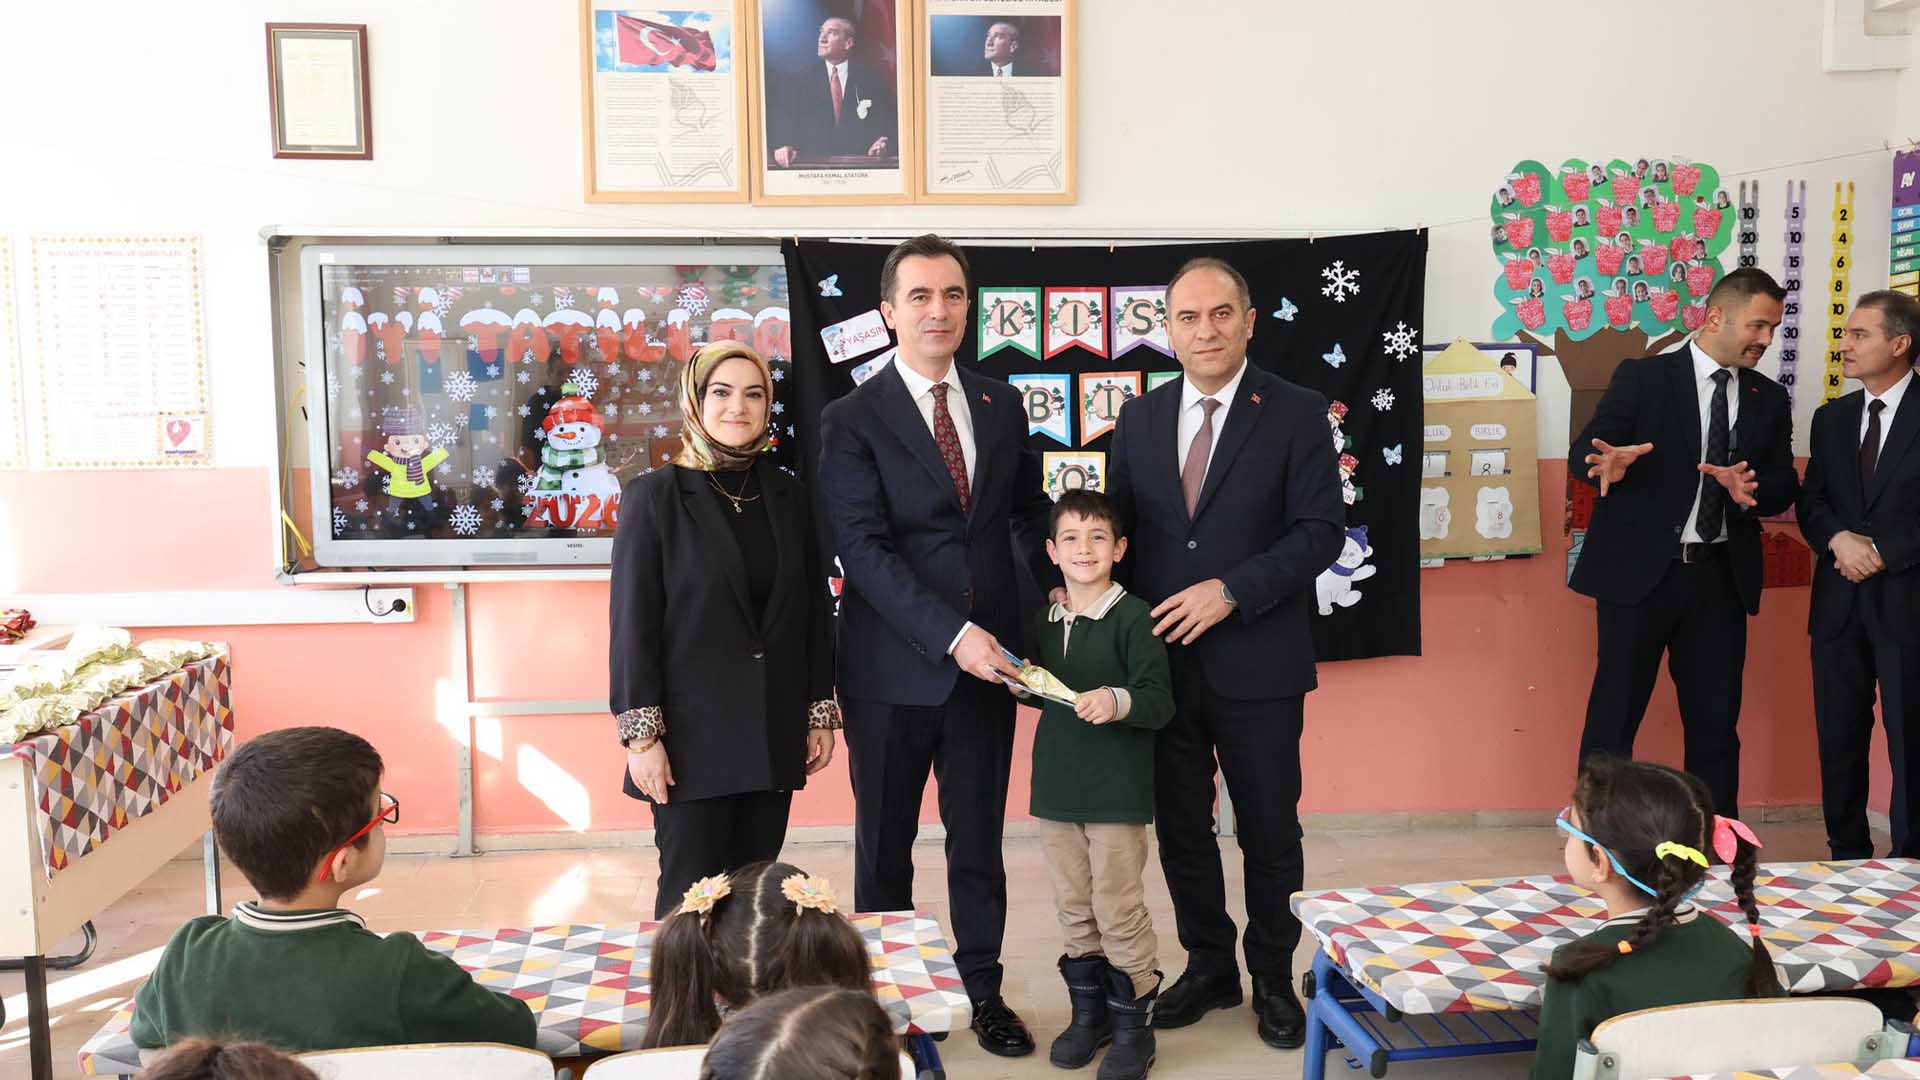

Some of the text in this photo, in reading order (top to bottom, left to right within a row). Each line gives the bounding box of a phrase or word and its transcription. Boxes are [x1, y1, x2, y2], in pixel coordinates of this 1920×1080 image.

[1901, 171, 1915, 188] AY
[1743, 208, 1754, 219] 10
[1792, 207, 1799, 218] 5
[1840, 209, 1847, 221] 2
[1742, 232, 1755, 243] 20
[1790, 232, 1801, 243] 10
[1839, 233, 1846, 244] 4
[1741, 255, 1755, 267] 30
[1789, 256, 1799, 267] 15
[1837, 256, 1844, 268] 6
[1787, 280, 1799, 291] 20
[1835, 280, 1842, 291] 8
[1785, 303, 1797, 314] 25
[1833, 304, 1844, 315] 10
[1784, 327, 1798, 338] 30
[1832, 328, 1842, 338] 12
[1783, 350, 1795, 361] 35
[1830, 351, 1841, 362] 14
[1780, 374, 1794, 385] 40
[1829, 375, 1838, 386] 16
[522, 492, 620, 529] 2026
